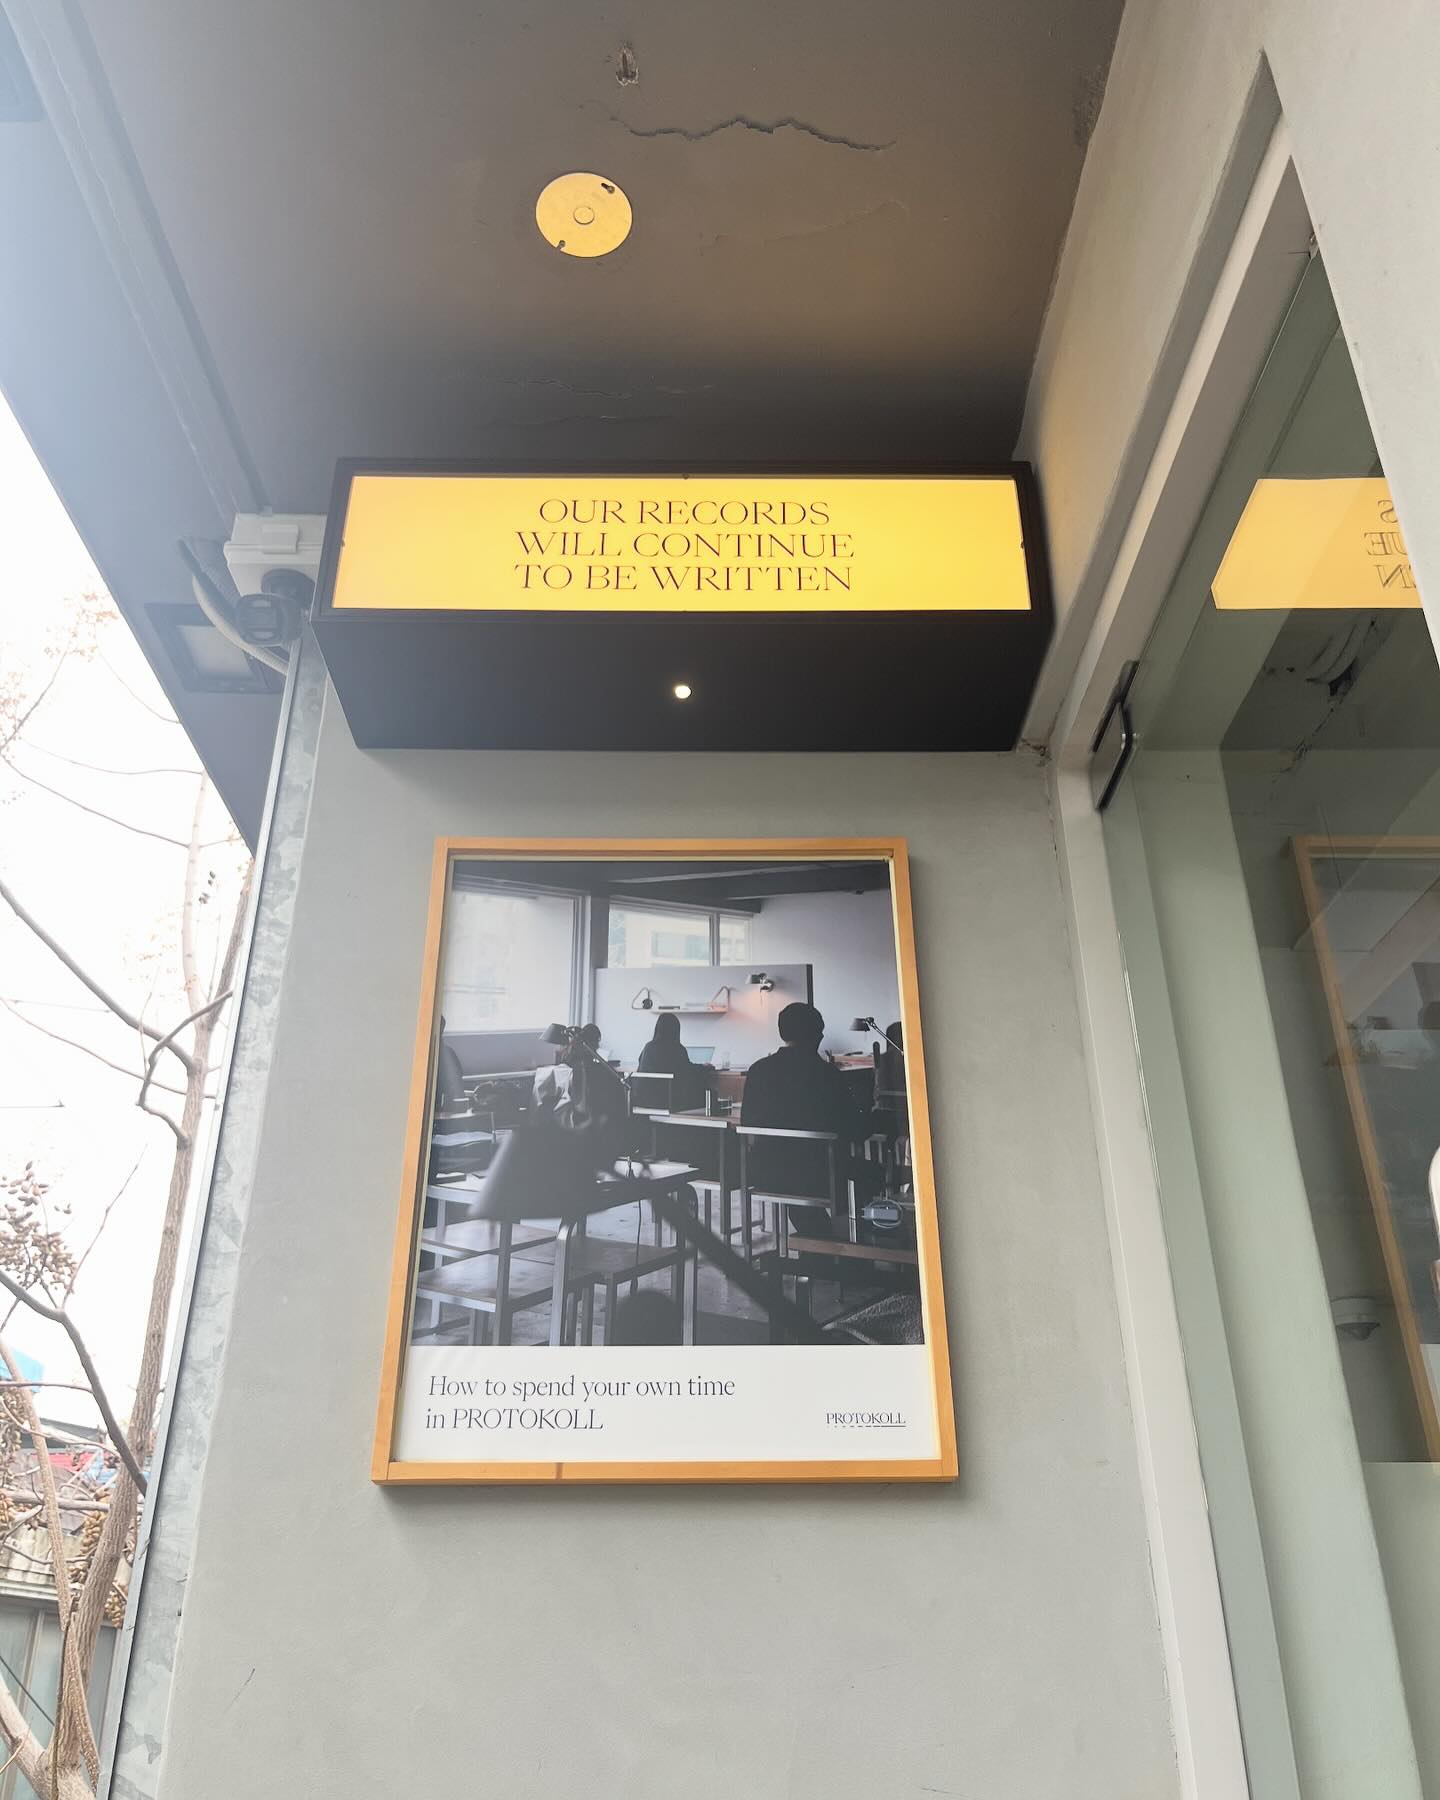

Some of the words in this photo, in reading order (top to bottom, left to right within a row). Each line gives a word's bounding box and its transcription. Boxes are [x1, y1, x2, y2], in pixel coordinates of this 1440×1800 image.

[540, 499, 626, 524] OUR
[637, 501, 829, 525] RECORDS
[515, 531, 622, 556] WILL
[634, 533, 854, 558] CONTINUE
[514, 564, 572, 589] TO
[586, 565, 637, 590] BE
[650, 566, 851, 591] WRITTEN
[429, 1376, 478, 1396] How
[485, 1379, 506, 1396] to
[512, 1375, 575, 1402] spend
[582, 1382, 631, 1403] your
[636, 1381, 681, 1397] own
[688, 1376, 735, 1396] time
[426, 1408, 444, 1429] in
[452, 1408, 603, 1429] PROTOKOLL
[826, 1412, 906, 1424] PROTOKOLL
